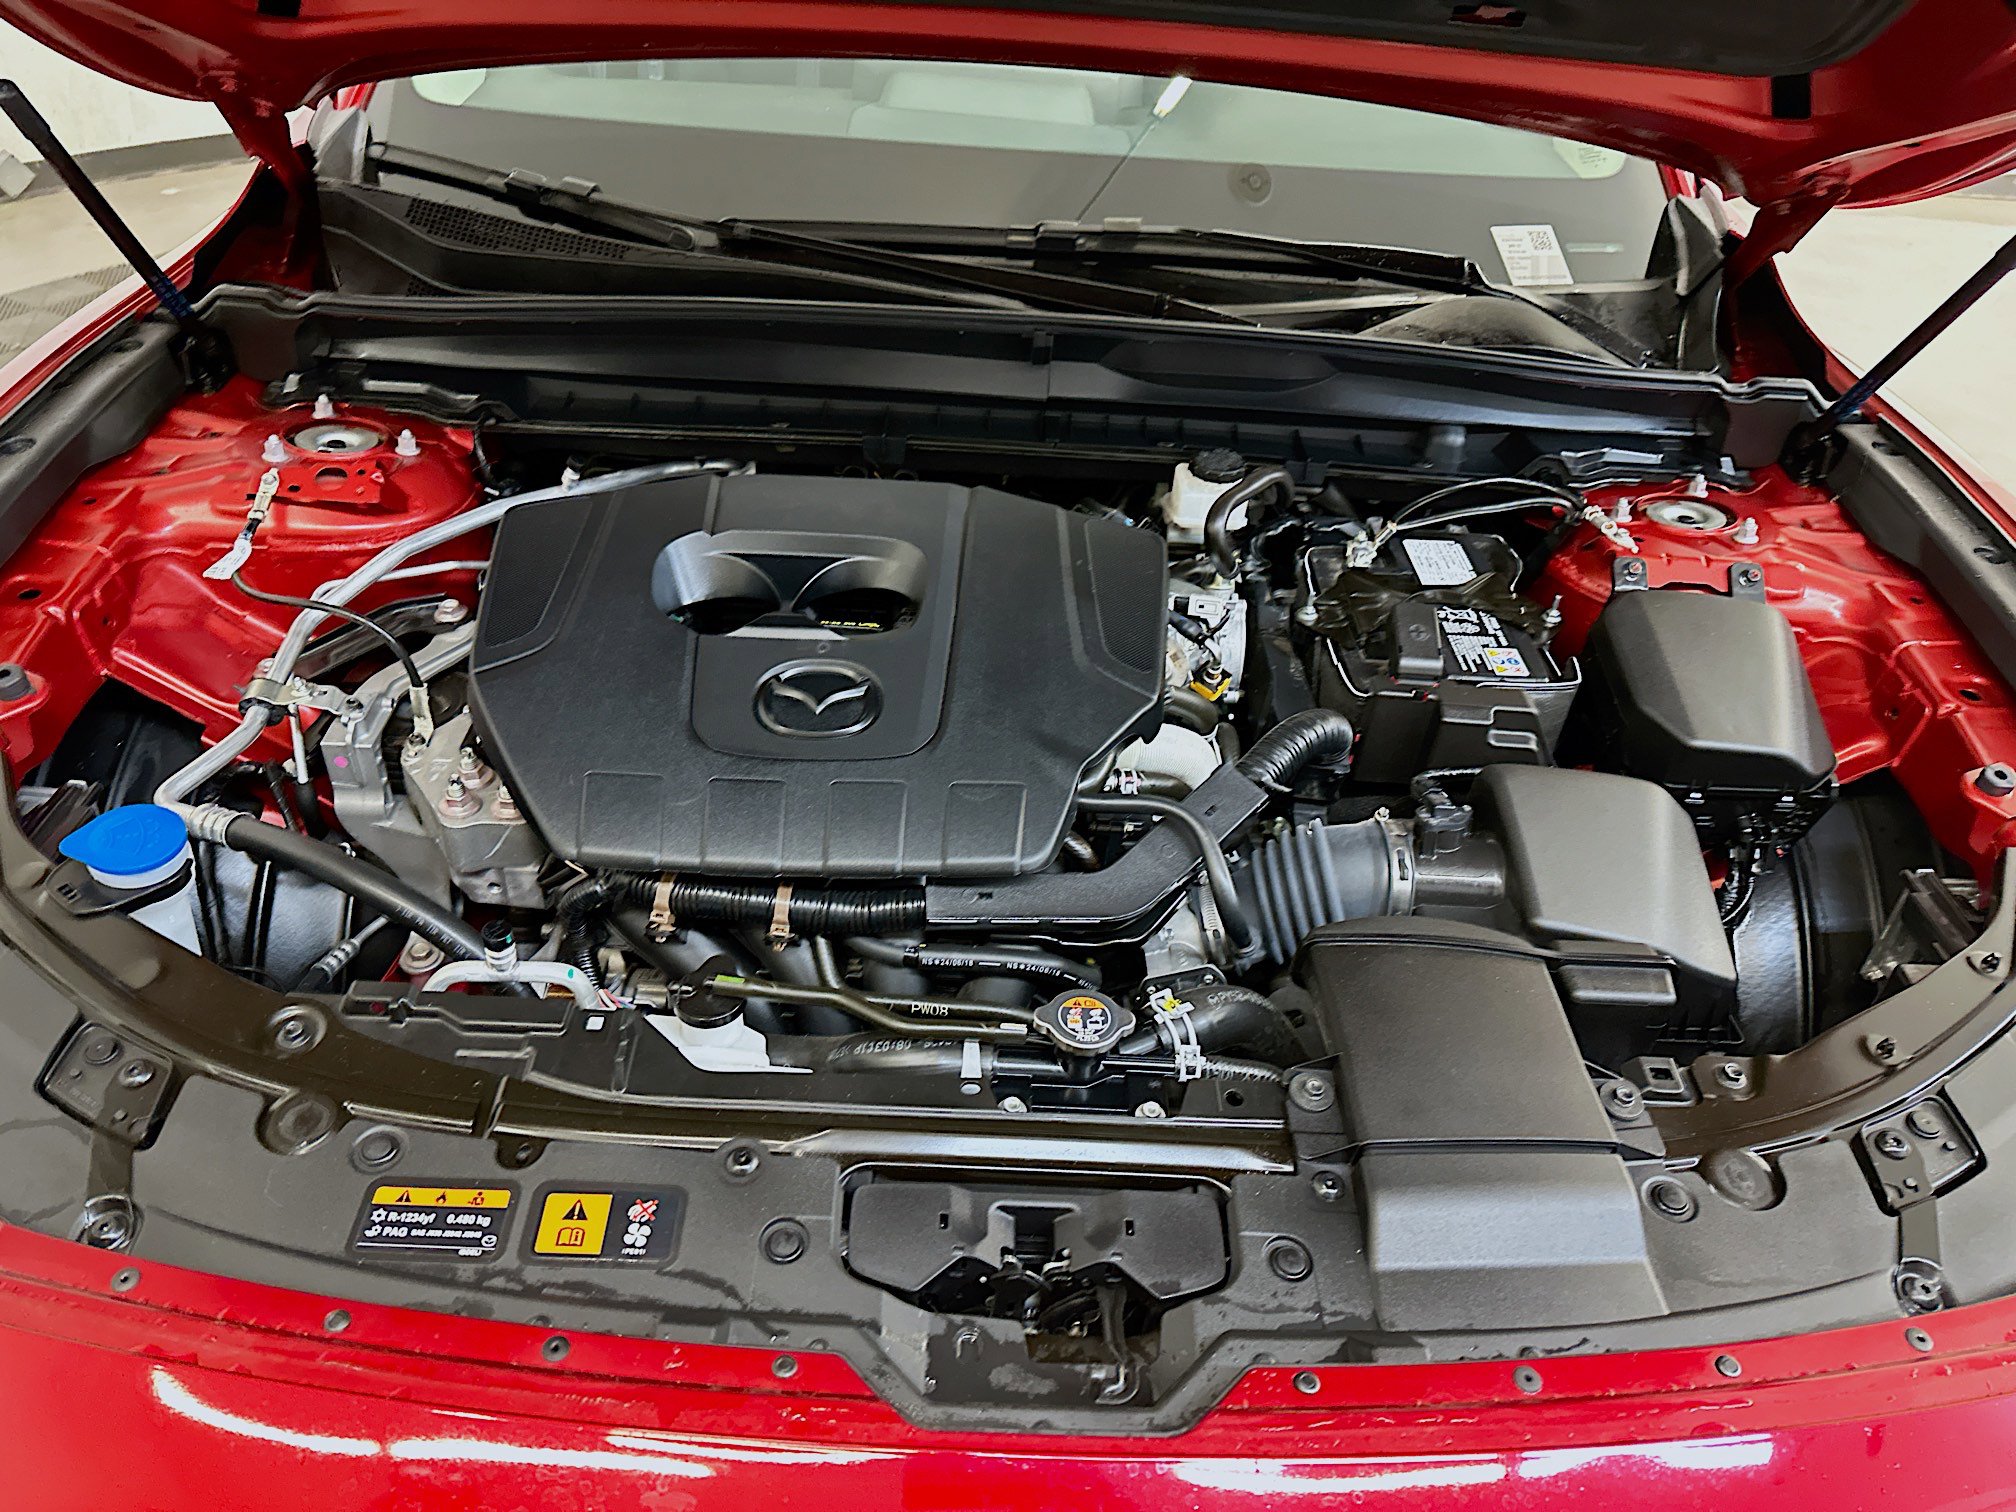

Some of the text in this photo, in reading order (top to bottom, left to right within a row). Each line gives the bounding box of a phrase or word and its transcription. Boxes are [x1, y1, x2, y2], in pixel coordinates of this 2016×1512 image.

[910, 1001, 950, 1018] PW08
[476, 1215, 491, 1227] kg
[382, 1226, 409, 1237] PAG
